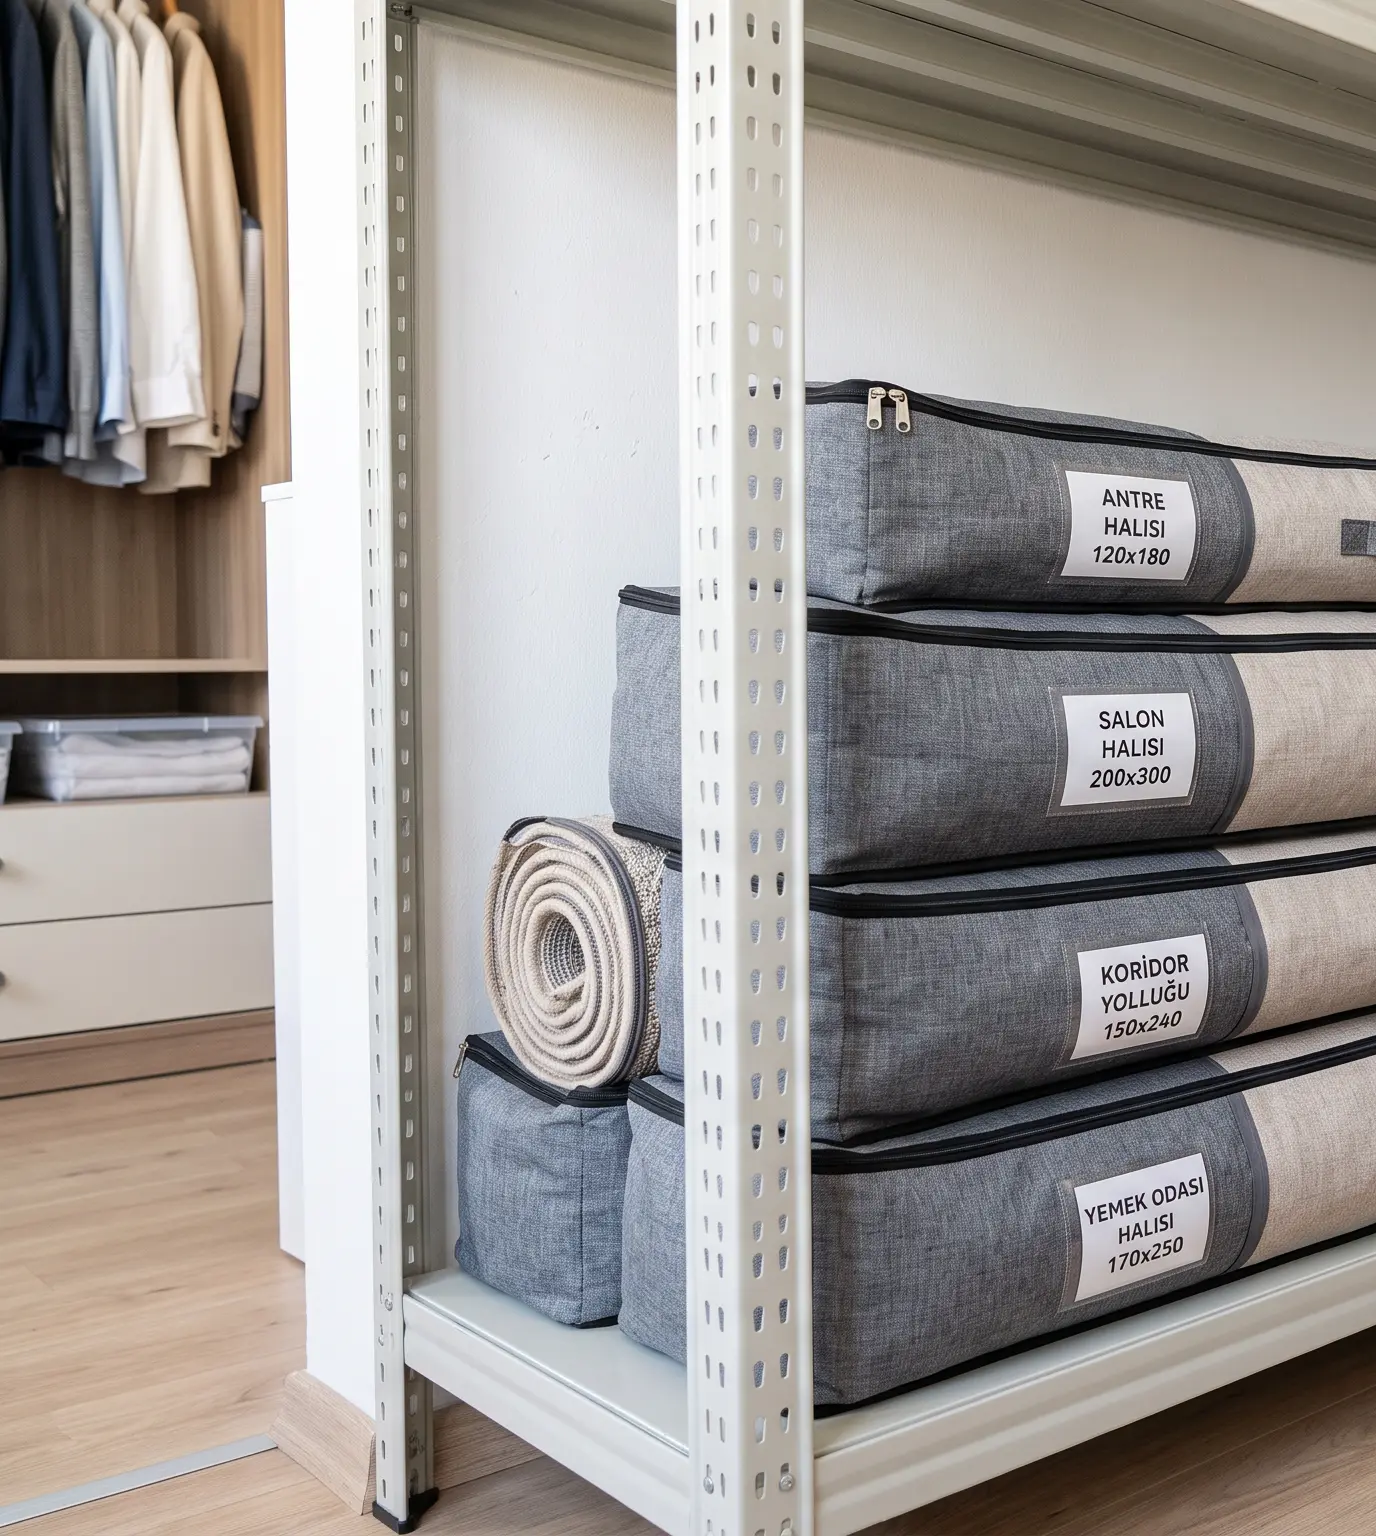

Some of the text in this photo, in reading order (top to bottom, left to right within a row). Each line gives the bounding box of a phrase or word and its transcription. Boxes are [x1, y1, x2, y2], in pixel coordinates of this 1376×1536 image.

[1102, 488, 1166, 511] ANTRE
[1104, 516, 1165, 539] HALISI
[1093, 545, 1171, 566] 120x180
[1099, 709, 1165, 730] SALON
[1102, 737, 1164, 759] HALISI
[1089, 765, 1171, 789] 200x300
[1101, 953, 1190, 986] KORİDOR
[1101, 979, 1190, 1014] YOLLUĞU
[1103, 1010, 1183, 1041] 150x240
[1084, 1176, 1204, 1226] YEMEK ODASI
[1118, 1212, 1175, 1245] HALISI
[1108, 1236, 1184, 1274] 170x250
